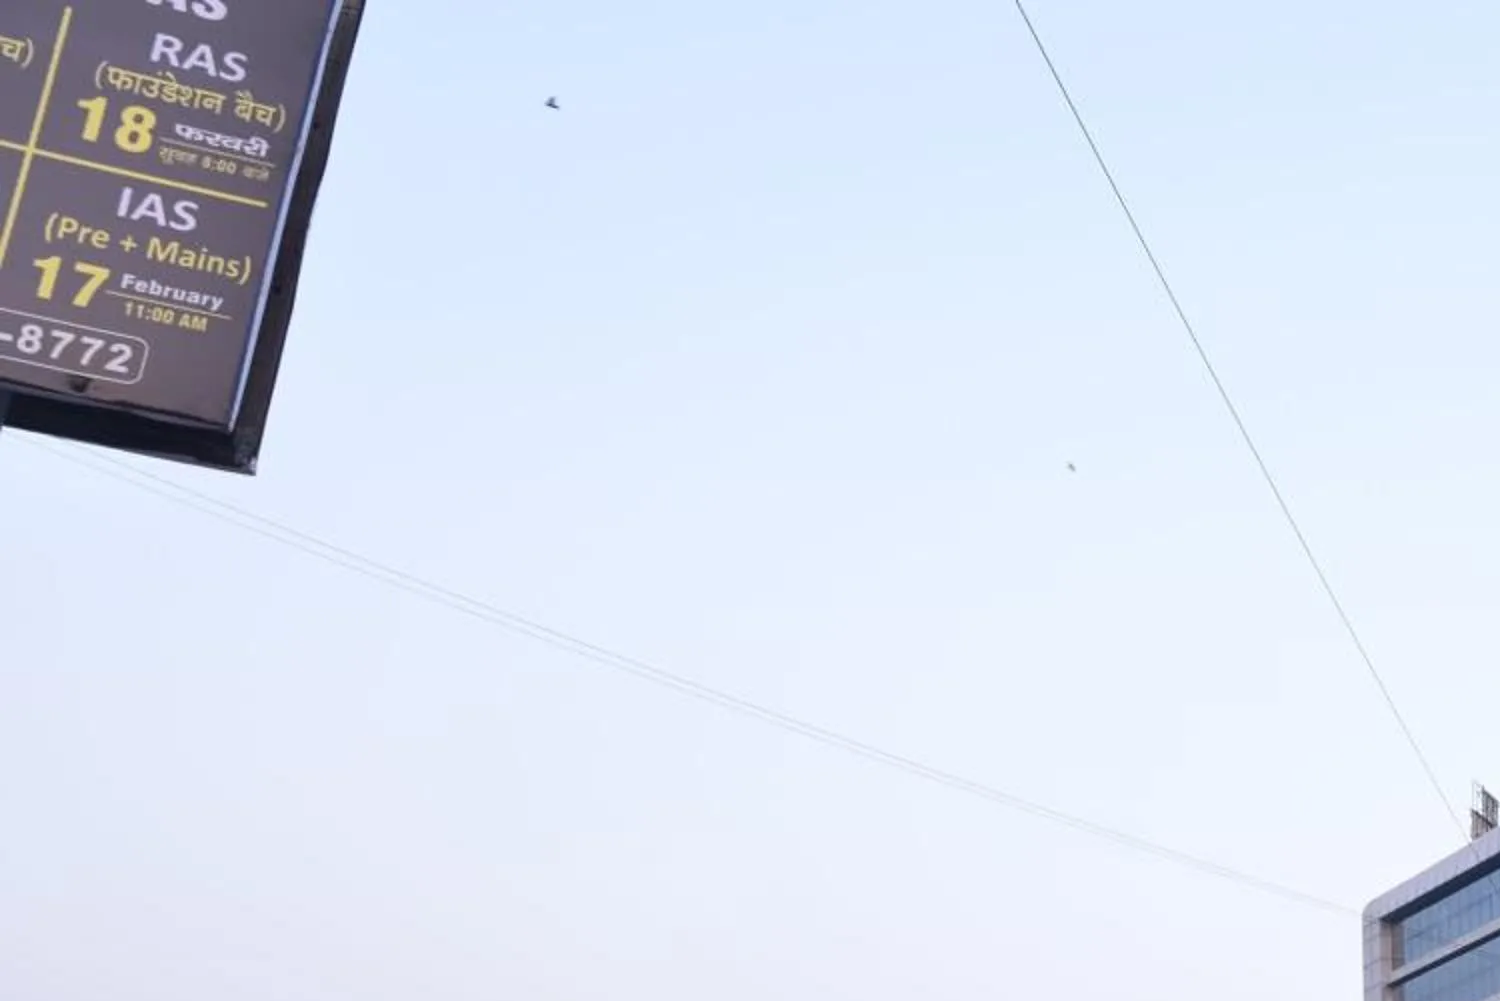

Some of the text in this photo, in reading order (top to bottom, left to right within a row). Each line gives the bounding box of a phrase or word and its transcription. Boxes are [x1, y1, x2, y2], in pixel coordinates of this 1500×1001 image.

[149, 33, 249, 82] RAS
[77, 96, 270, 158] 18 फरवरी
[116, 186, 199, 232] IAS
[44, 212, 112, 250] (Pre
[146, 237, 251, 285] Mains)
[32, 256, 224, 312] 17 February
[123, 301, 208, 332] 11:00 AM
